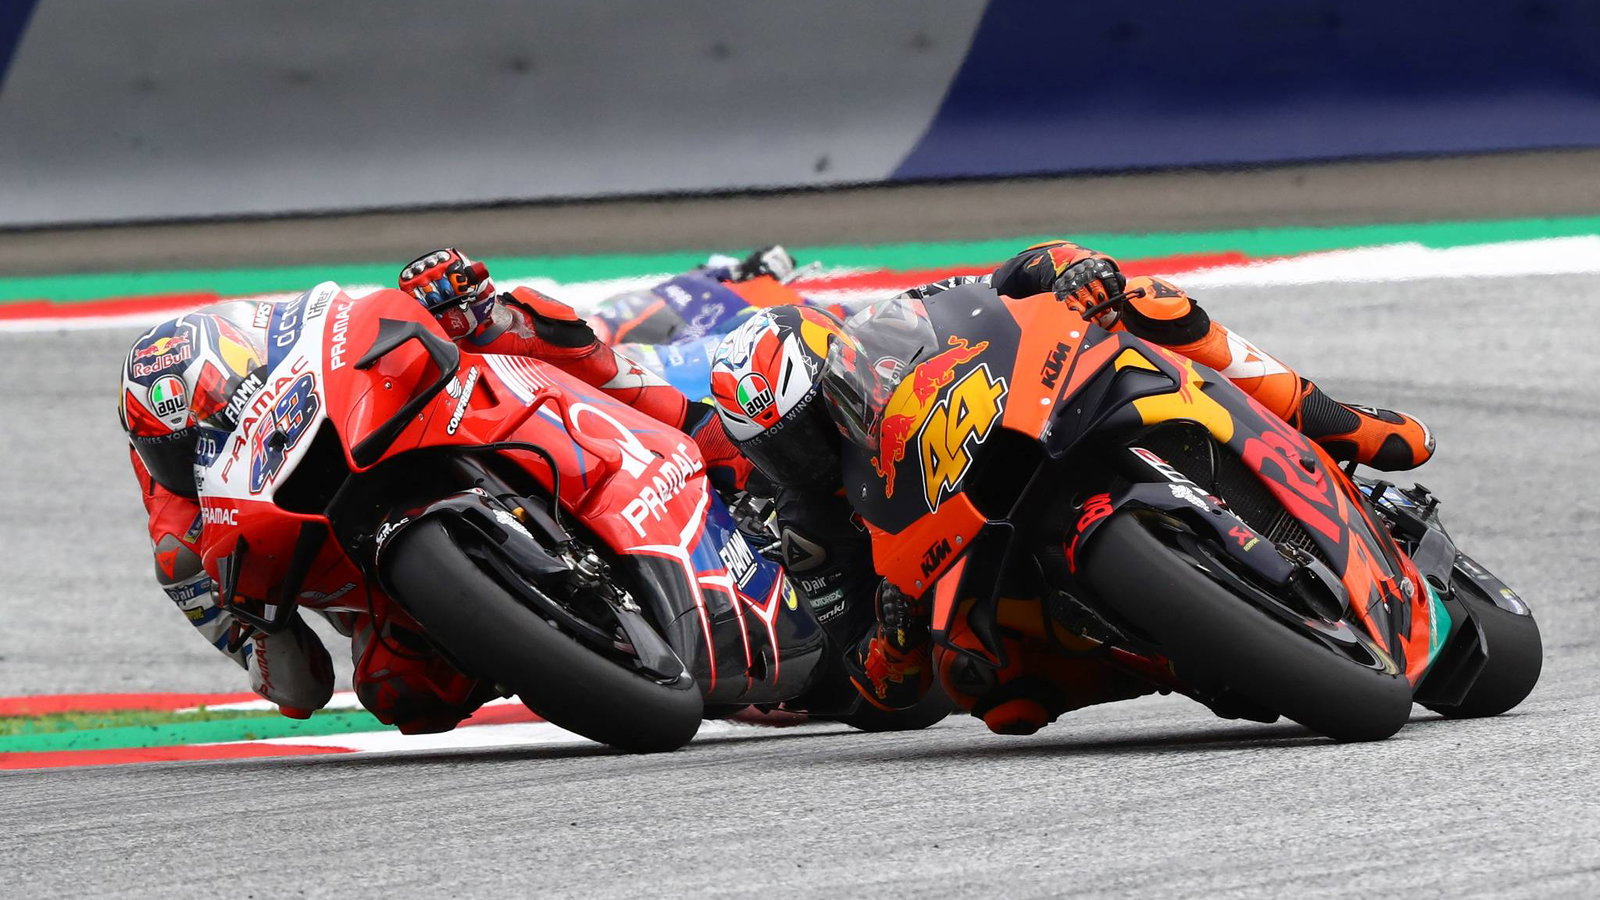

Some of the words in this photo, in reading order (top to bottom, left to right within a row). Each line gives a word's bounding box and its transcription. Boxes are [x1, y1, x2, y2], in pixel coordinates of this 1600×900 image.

[133, 357, 161, 378] Red
[161, 344, 192, 368] Bull
[331, 301, 354, 371] PRAMAC
[1041, 341, 1072, 390] KTM
[221, 356, 309, 484] PRAMAC
[224, 373, 262, 424] FIAMM
[447, 364, 478, 435] CONFREMAR
[763, 422, 785, 437] YOU
[786, 388, 817, 421] WINGS
[166, 429, 189, 440] YOU
[249, 371, 321, 496] 43
[917, 362, 1009, 515] 44
[620, 443, 703, 539] PRAMAC
[920, 538, 952, 579] KTM
